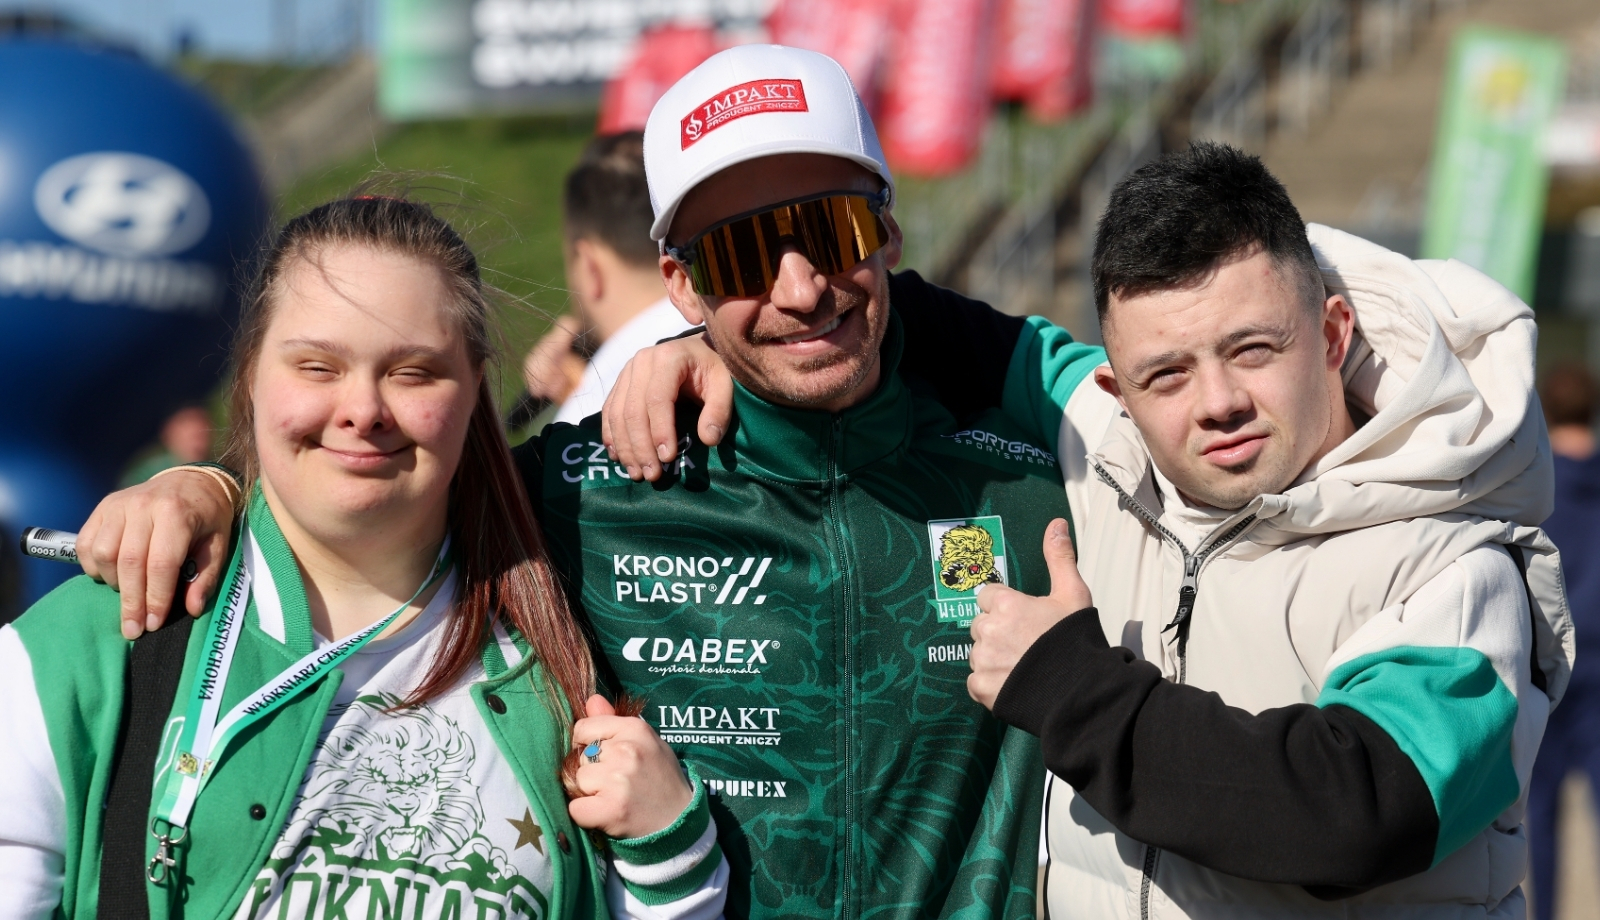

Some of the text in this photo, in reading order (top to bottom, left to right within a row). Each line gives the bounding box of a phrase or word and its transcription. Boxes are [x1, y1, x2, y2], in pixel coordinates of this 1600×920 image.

[703, 84, 796, 120] IMPAKT
[706, 104, 762, 130] PRODUCENT
[940, 430, 1056, 463] PORTGANG
[954, 437, 1054, 468] SPORTSWEAR
[31, 545, 56, 557] 2000
[613, 555, 720, 578] KRONO
[198, 606, 237, 701] CZĘSTOCHOWA
[648, 662, 761, 676] czystość doskonała
[242, 662, 321, 717] WŁÓKNIARZ
[658, 705, 780, 730] IMPAKT
[660, 734, 781, 746] PRODUCENT ZNICZY
[702, 779, 787, 798] PUREX
